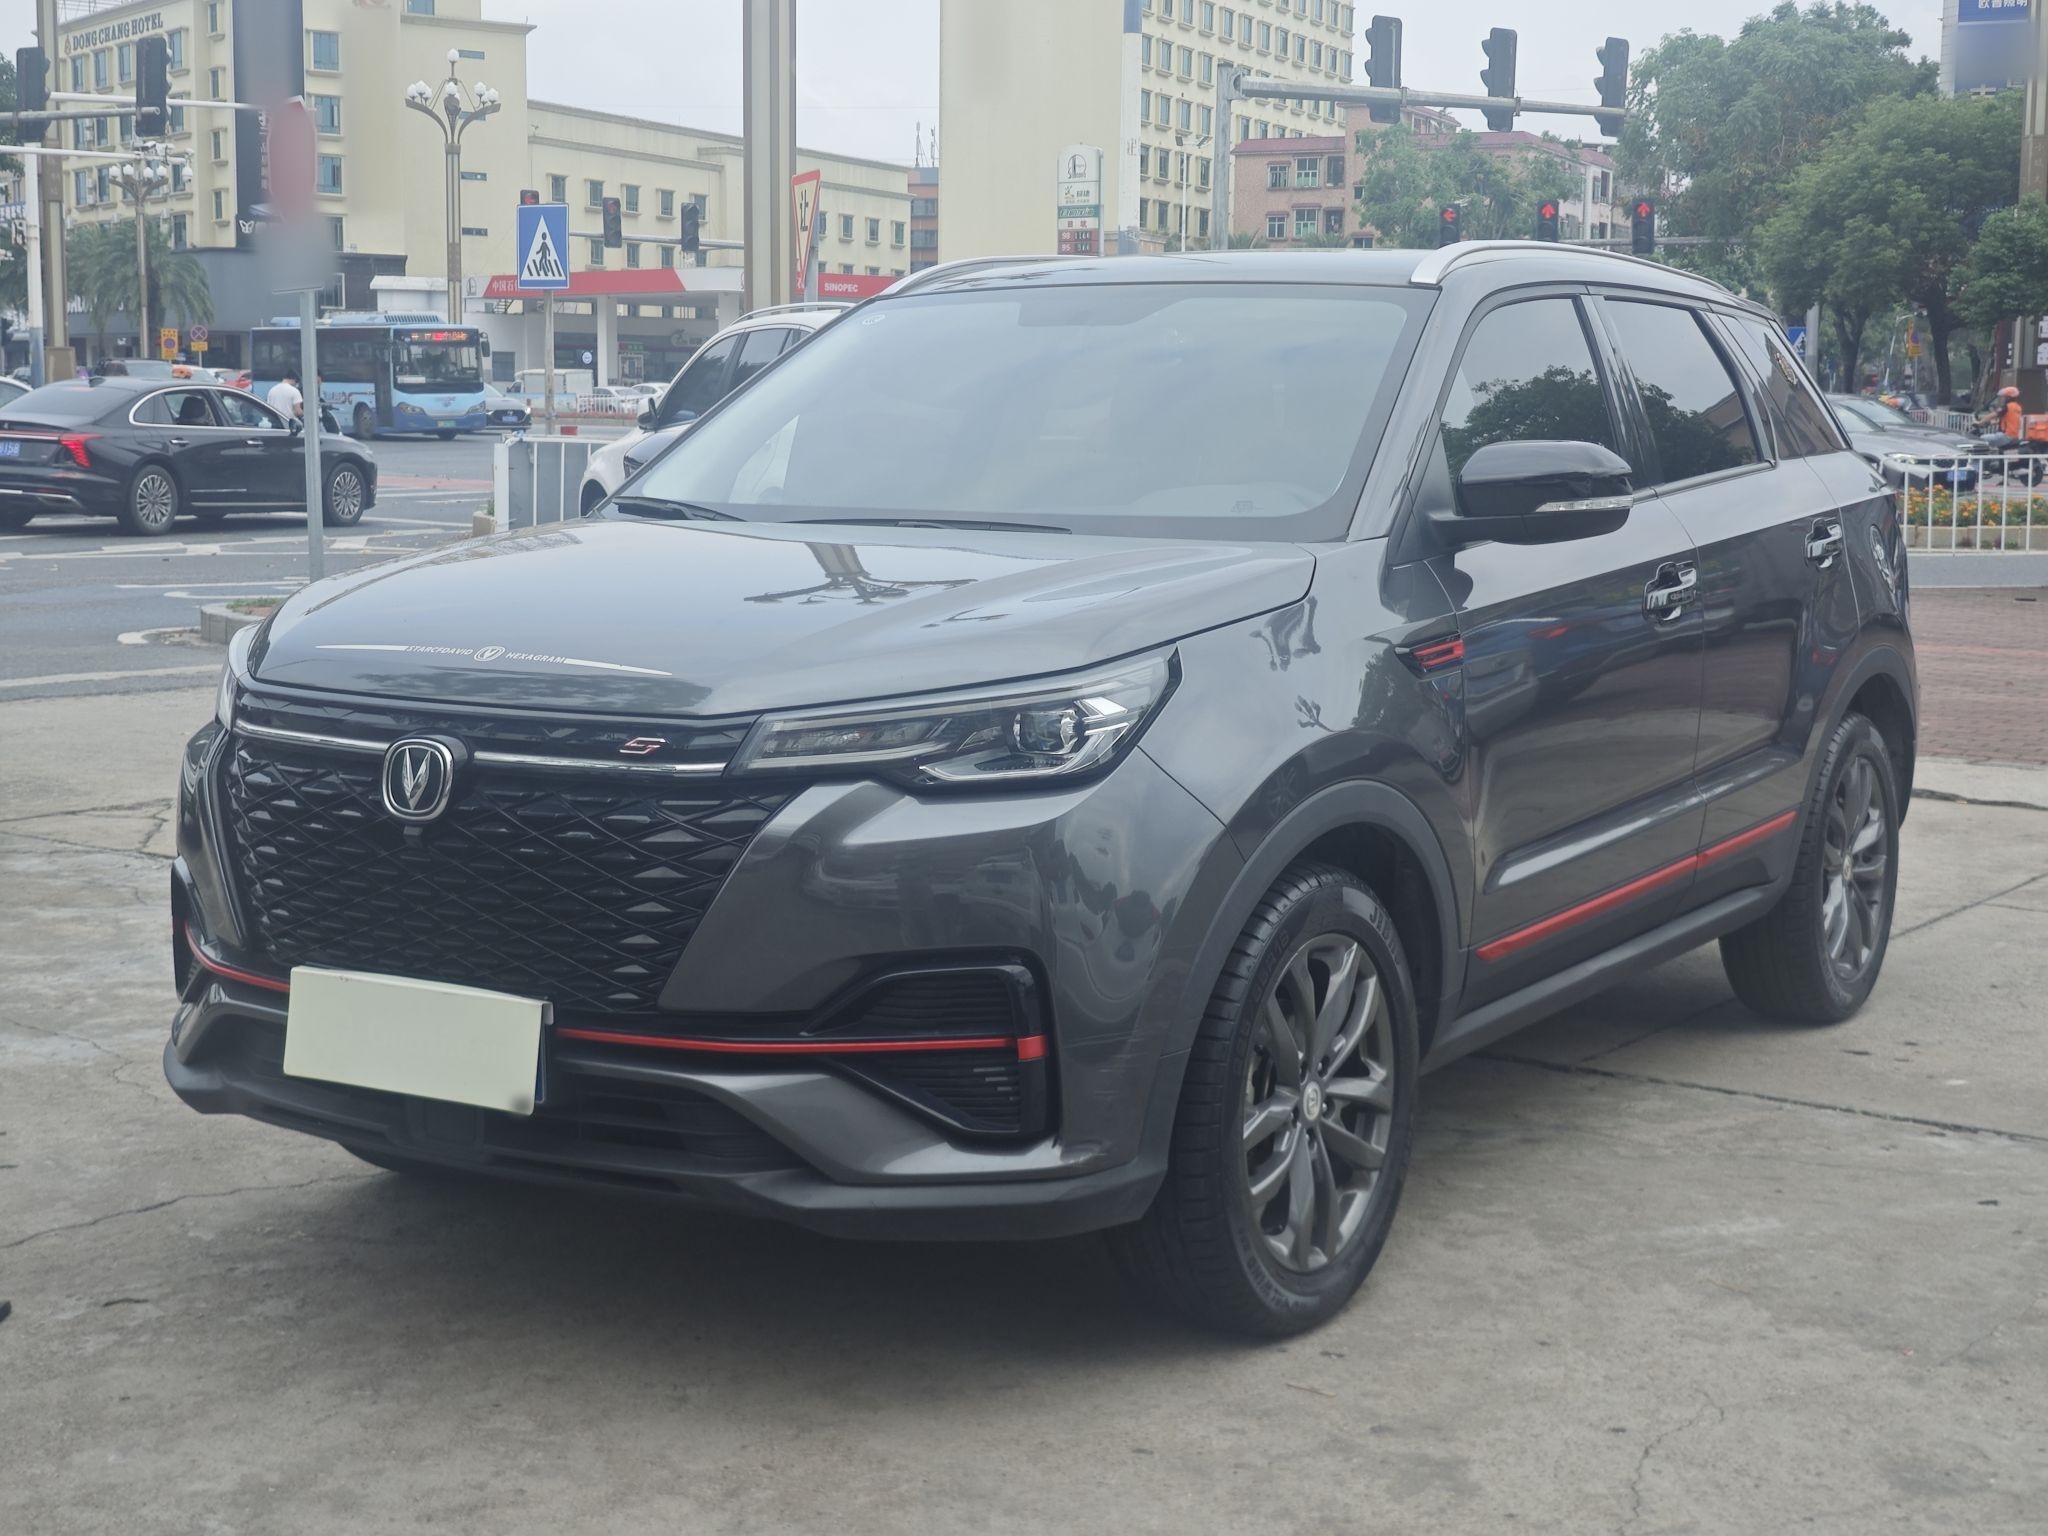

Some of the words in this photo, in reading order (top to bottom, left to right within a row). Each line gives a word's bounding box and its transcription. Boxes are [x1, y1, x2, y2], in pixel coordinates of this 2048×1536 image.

[72, 31, 97, 51] DONG
[99, 21, 130, 45] CHANG
[131, 12, 164, 35] HOTEL
[824, 282, 859, 293] SINOPEC
[505, 650, 565, 664] HEXAGRAM
